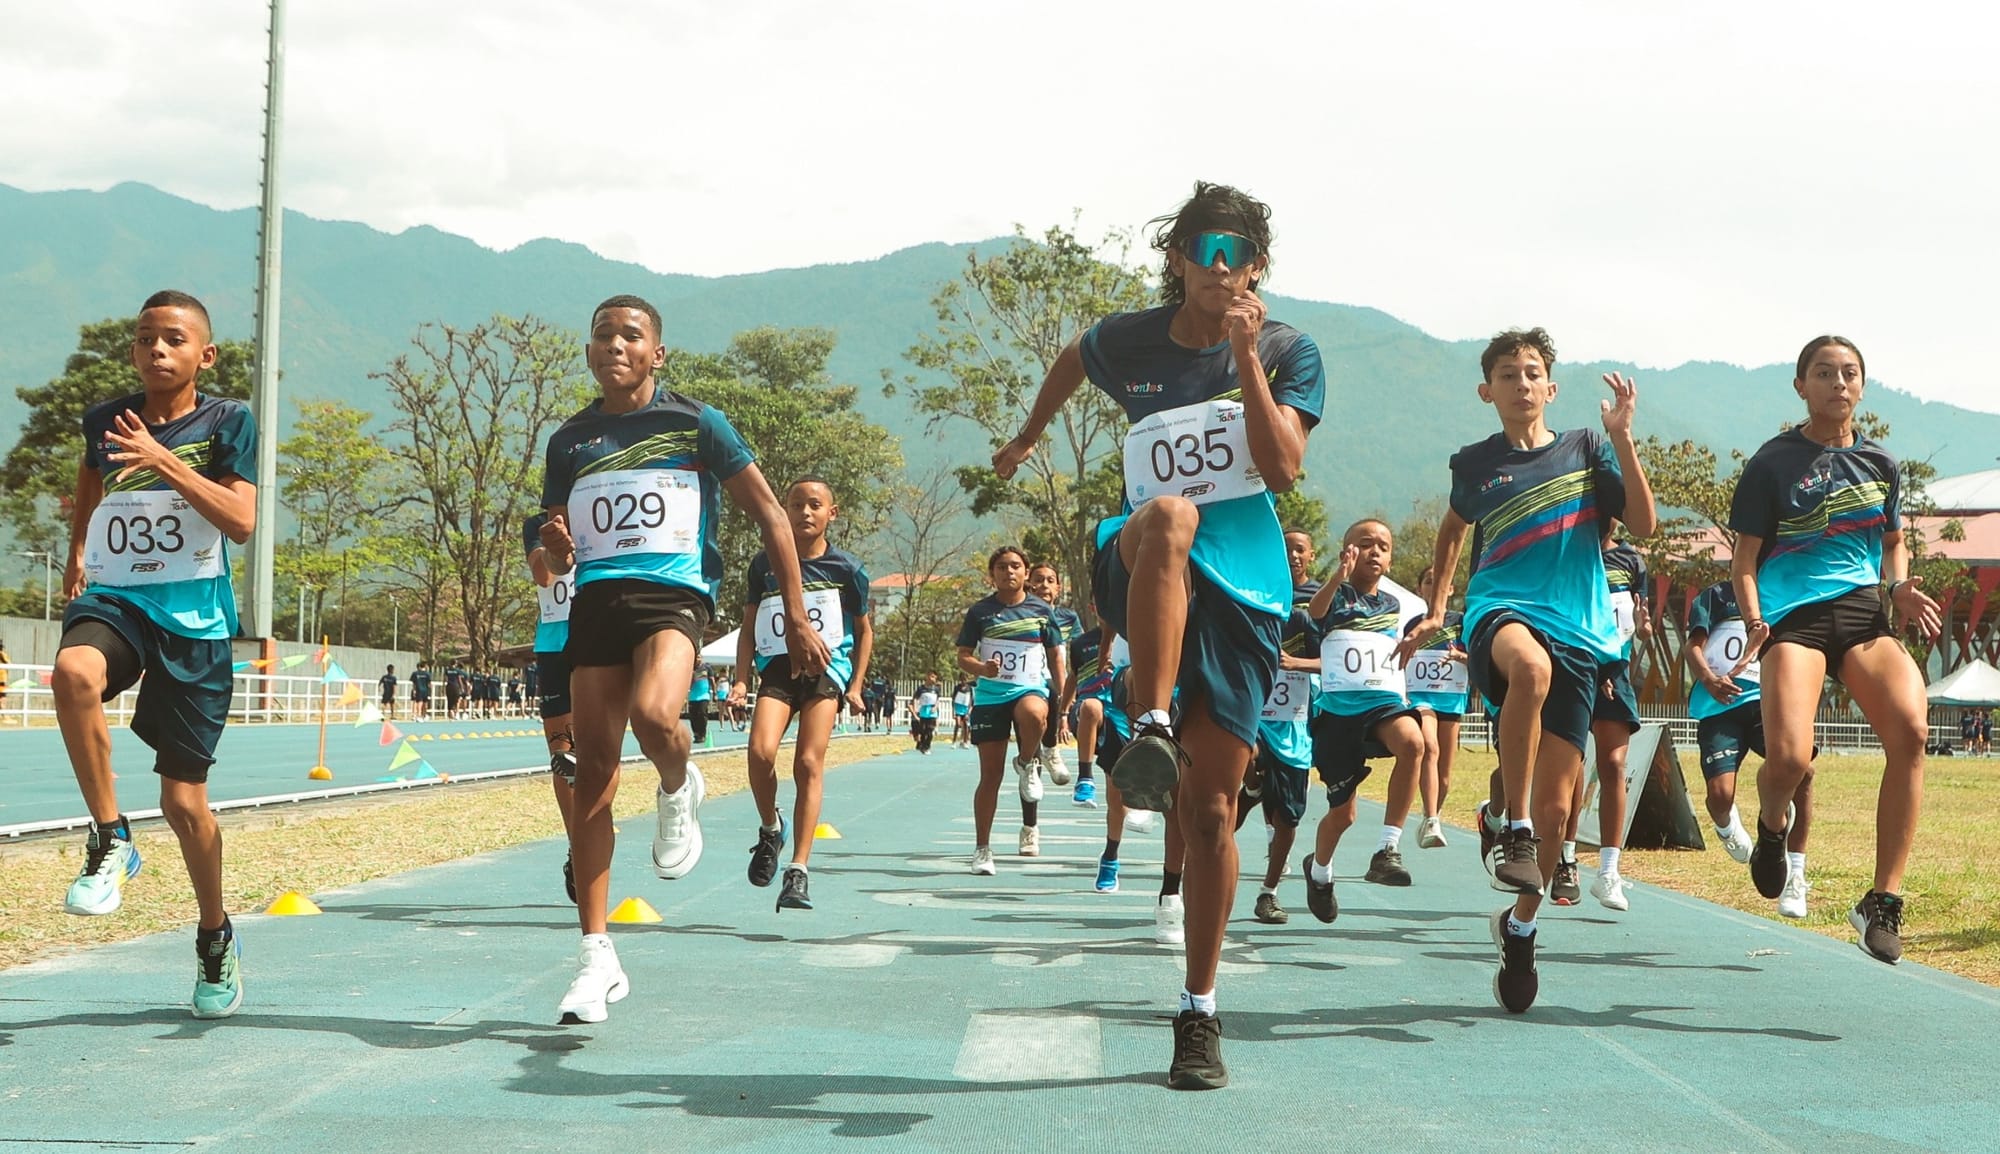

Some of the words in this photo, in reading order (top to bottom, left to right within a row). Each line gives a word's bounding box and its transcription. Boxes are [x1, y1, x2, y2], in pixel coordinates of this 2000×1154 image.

[1151, 427, 1234, 482] 035
[592, 492, 665, 534] 029
[107, 515, 184, 555] 033
[771, 607, 824, 638] 08
[1344, 647, 1396, 675] 014
[1415, 661, 1454, 681] 032
